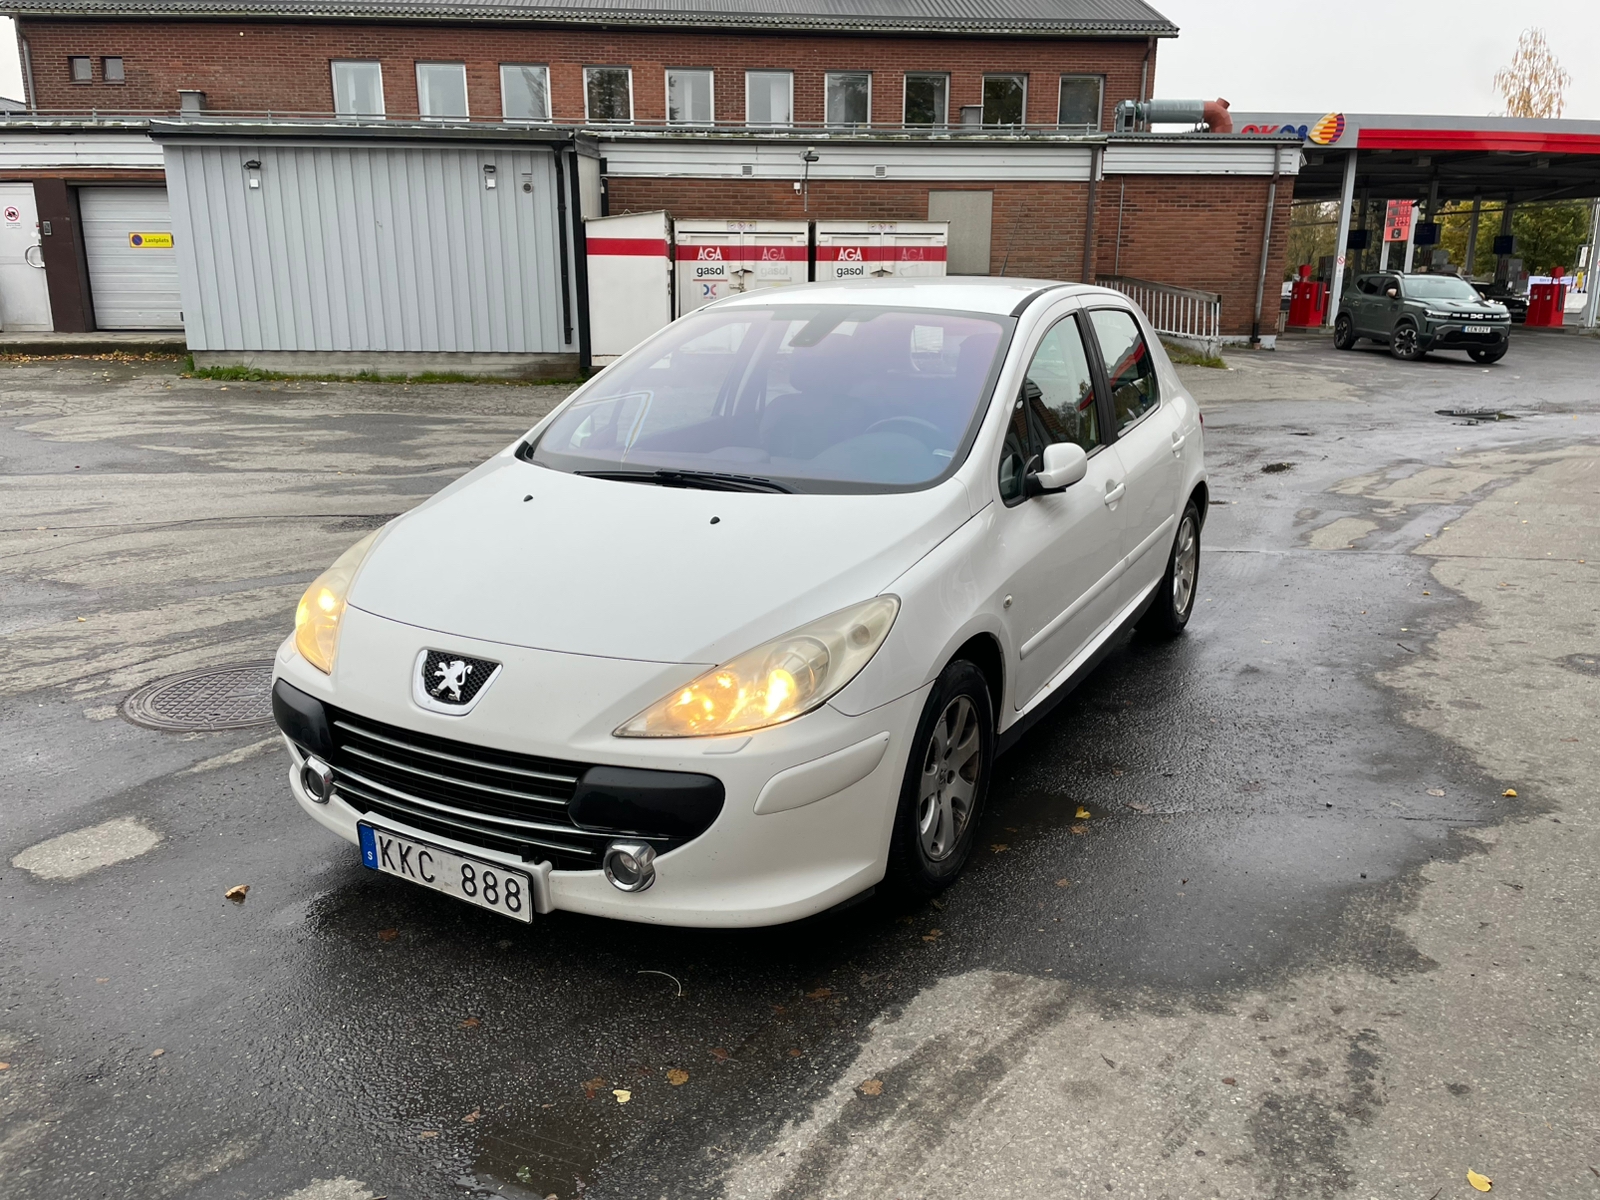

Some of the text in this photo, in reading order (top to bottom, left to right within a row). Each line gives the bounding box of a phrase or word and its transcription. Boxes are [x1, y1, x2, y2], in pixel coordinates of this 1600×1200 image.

[697, 246, 723, 260] AGA
[762, 246, 786, 260] AGA
[838, 247, 863, 261] AGA
[696, 265, 725, 278] gasol
[836, 265, 864, 278] gasol
[367, 850, 373, 861] S
[378, 835, 522, 913] KKC 888
